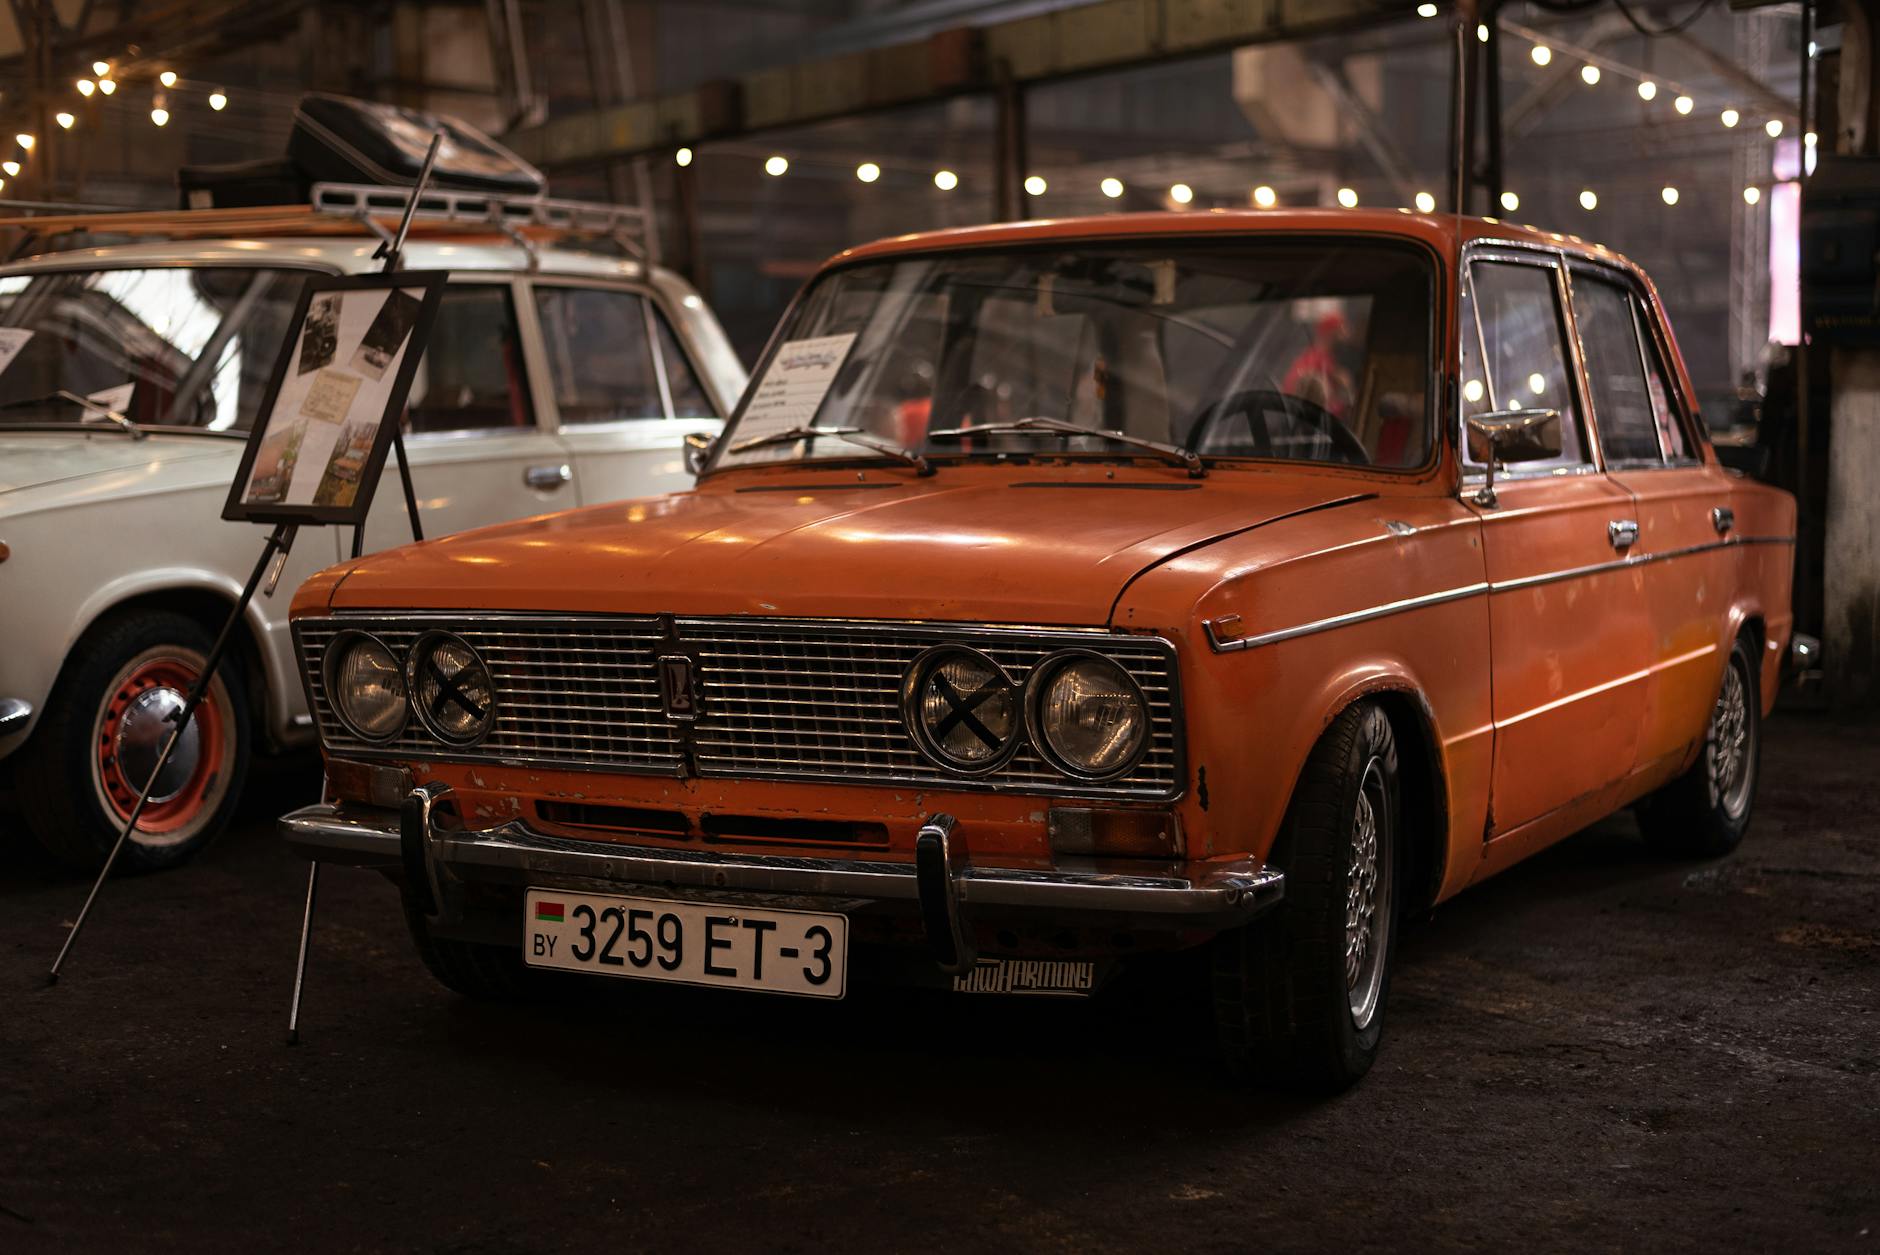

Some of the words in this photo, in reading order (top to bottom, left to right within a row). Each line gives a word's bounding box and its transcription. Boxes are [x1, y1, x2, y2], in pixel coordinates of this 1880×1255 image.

[533, 933, 558, 957] BY
[571, 904, 683, 971] 3259
[704, 916, 833, 986] ET-3
